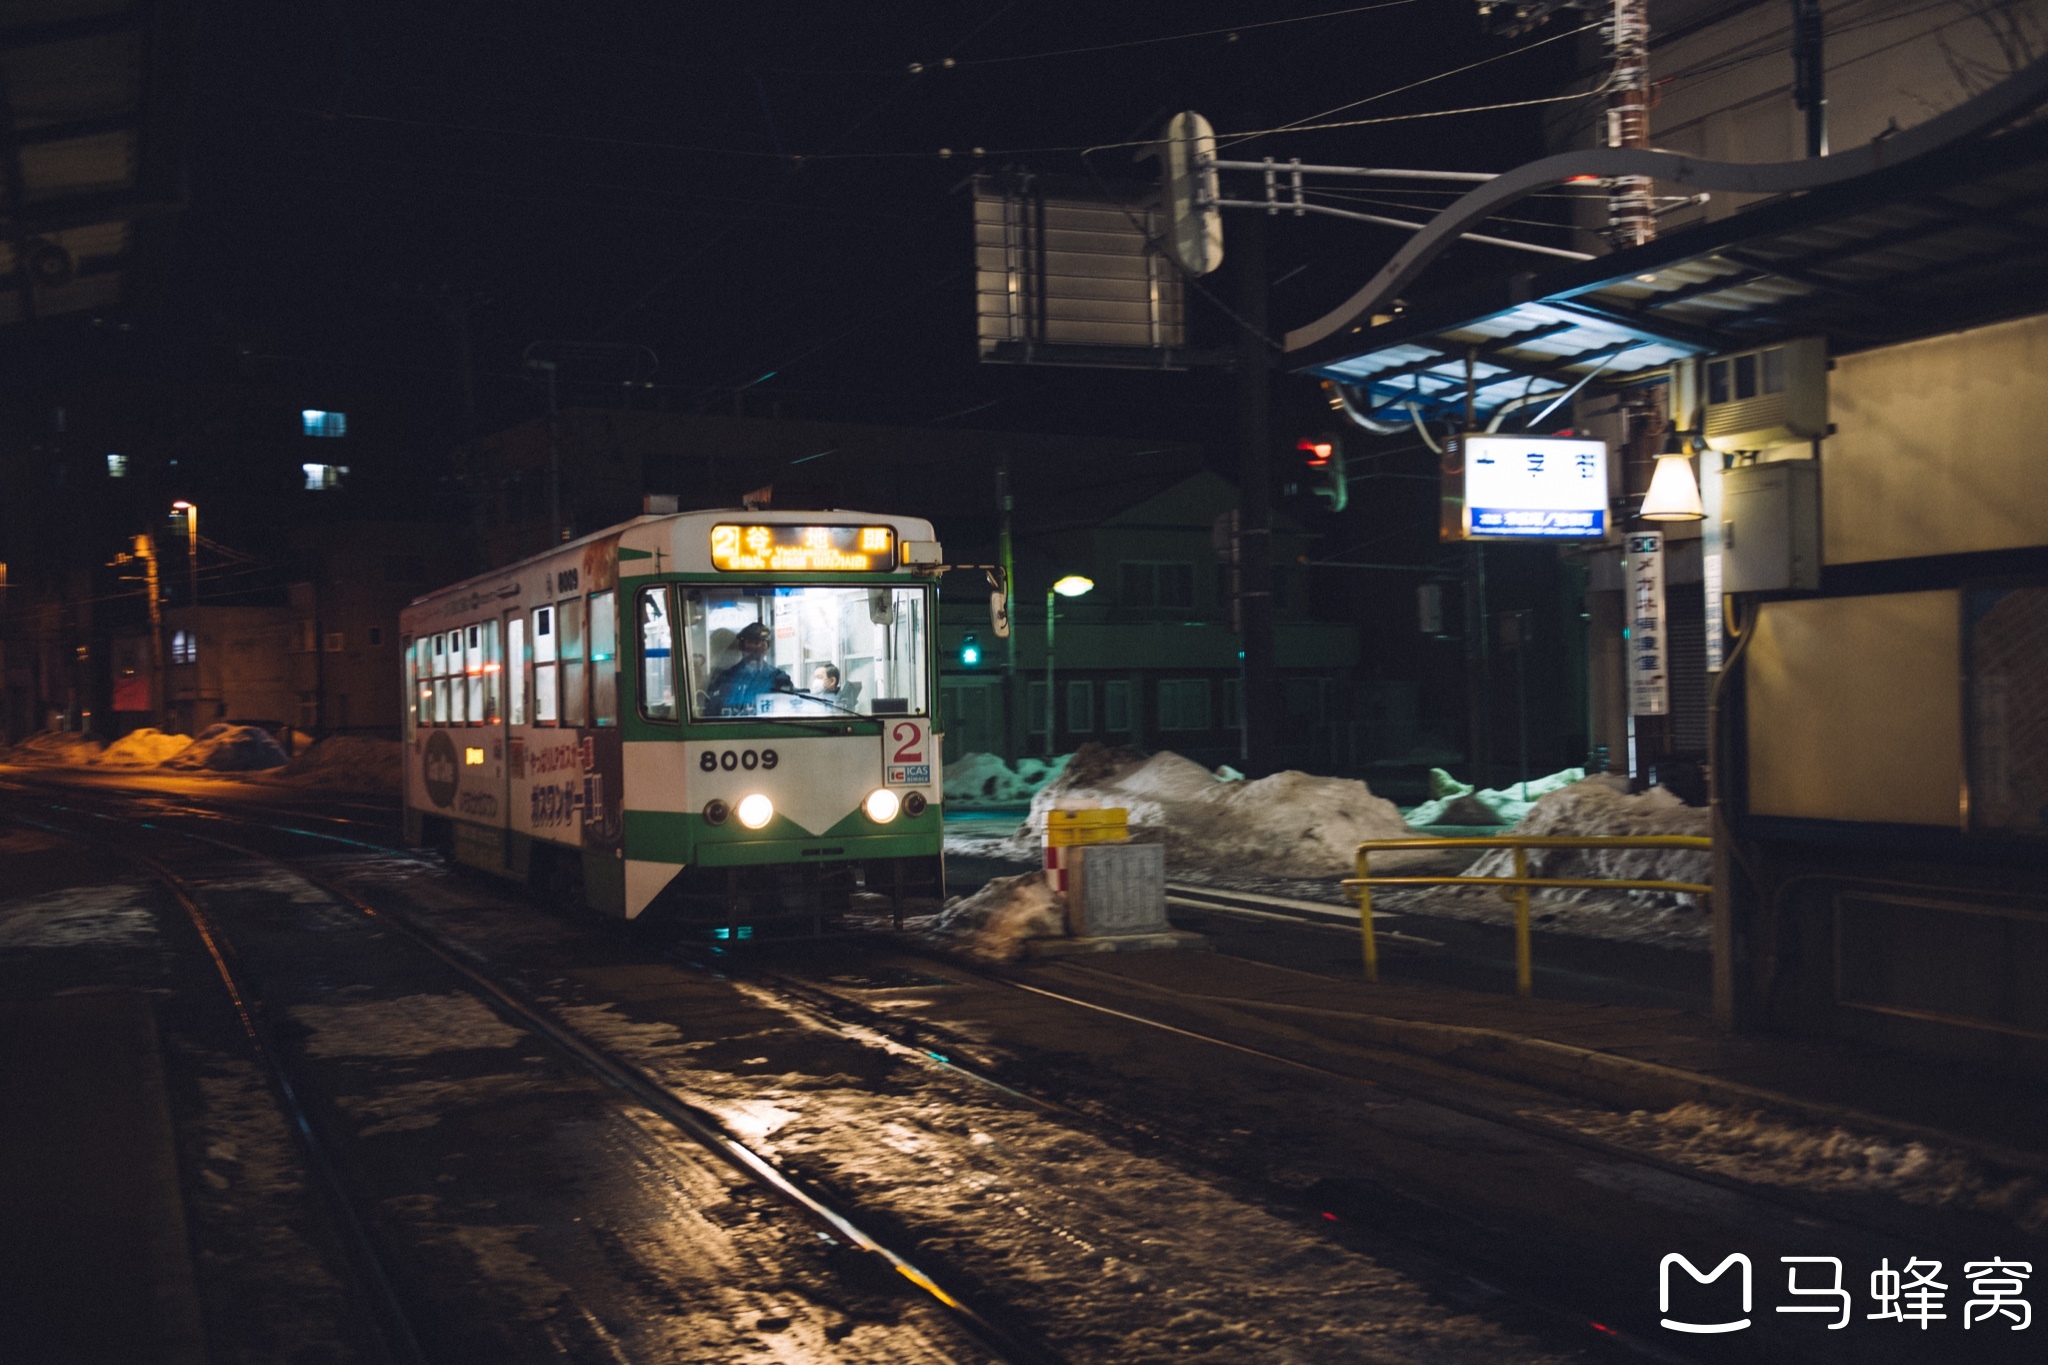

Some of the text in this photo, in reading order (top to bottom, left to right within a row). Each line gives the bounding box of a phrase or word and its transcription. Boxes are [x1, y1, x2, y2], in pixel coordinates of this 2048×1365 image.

[715, 528, 736, 556] 2
[892, 722, 922, 763] 2
[700, 749, 779, 772] 8009
[906, 766, 928, 776] ICAS
